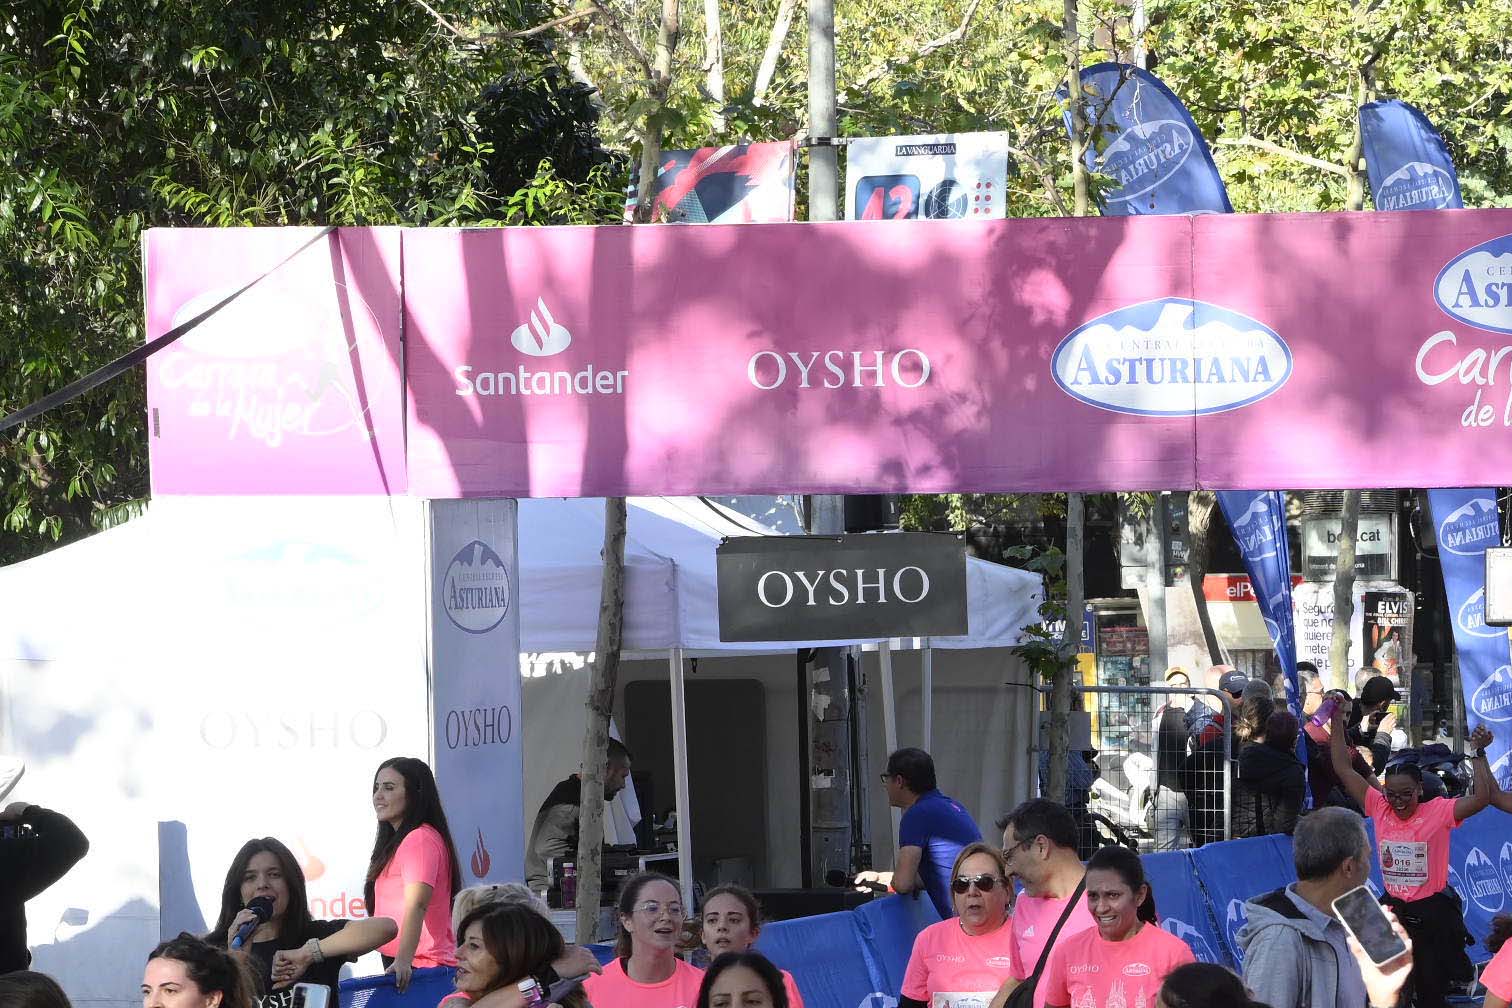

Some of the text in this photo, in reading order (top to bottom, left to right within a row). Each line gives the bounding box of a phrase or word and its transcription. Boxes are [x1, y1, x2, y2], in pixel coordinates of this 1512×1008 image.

[455, 365, 629, 397] Santander
[747, 348, 932, 391] OYSHO
[1069, 339, 1274, 388] ASTURIANA
[1461, 388, 1496, 428] de
[448, 575, 507, 610] ASTURIANA
[756, 565, 932, 609] OYSHO
[1377, 601, 1409, 614] ELVIS
[200, 709, 388, 752] OYSHO
[445, 704, 512, 750] OYSHO
[1394, 858, 1411, 867] 016
